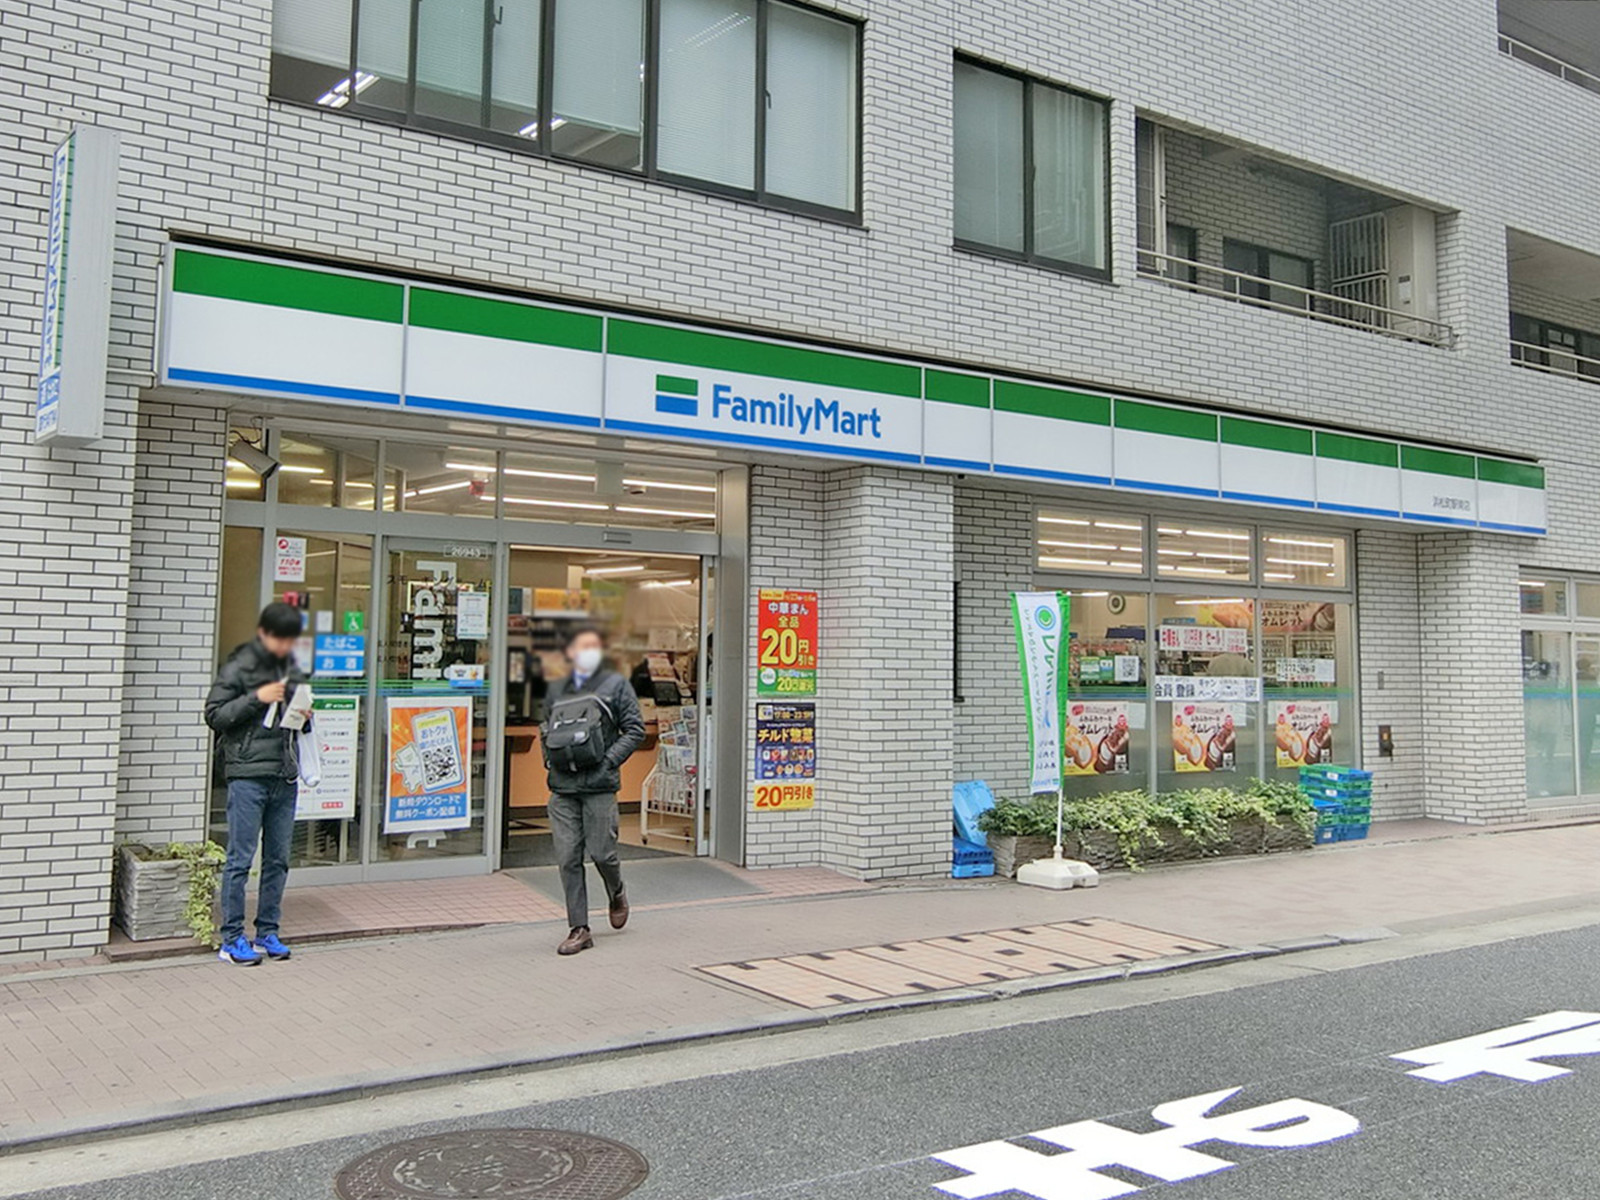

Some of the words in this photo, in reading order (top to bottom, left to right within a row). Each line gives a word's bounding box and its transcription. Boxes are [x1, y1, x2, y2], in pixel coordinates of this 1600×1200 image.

[712, 383, 881, 438] FamilyMart
[768, 601, 809, 615] 中華まん
[778, 615, 800, 628] 全品
[324, 636, 357, 649] たばこ
[1078, 723, 1113, 735] オムレット
[1190, 722, 1221, 734] オムレット
[757, 728, 813, 743] チルド惣菜
[756, 785, 813, 807] 20円引き
